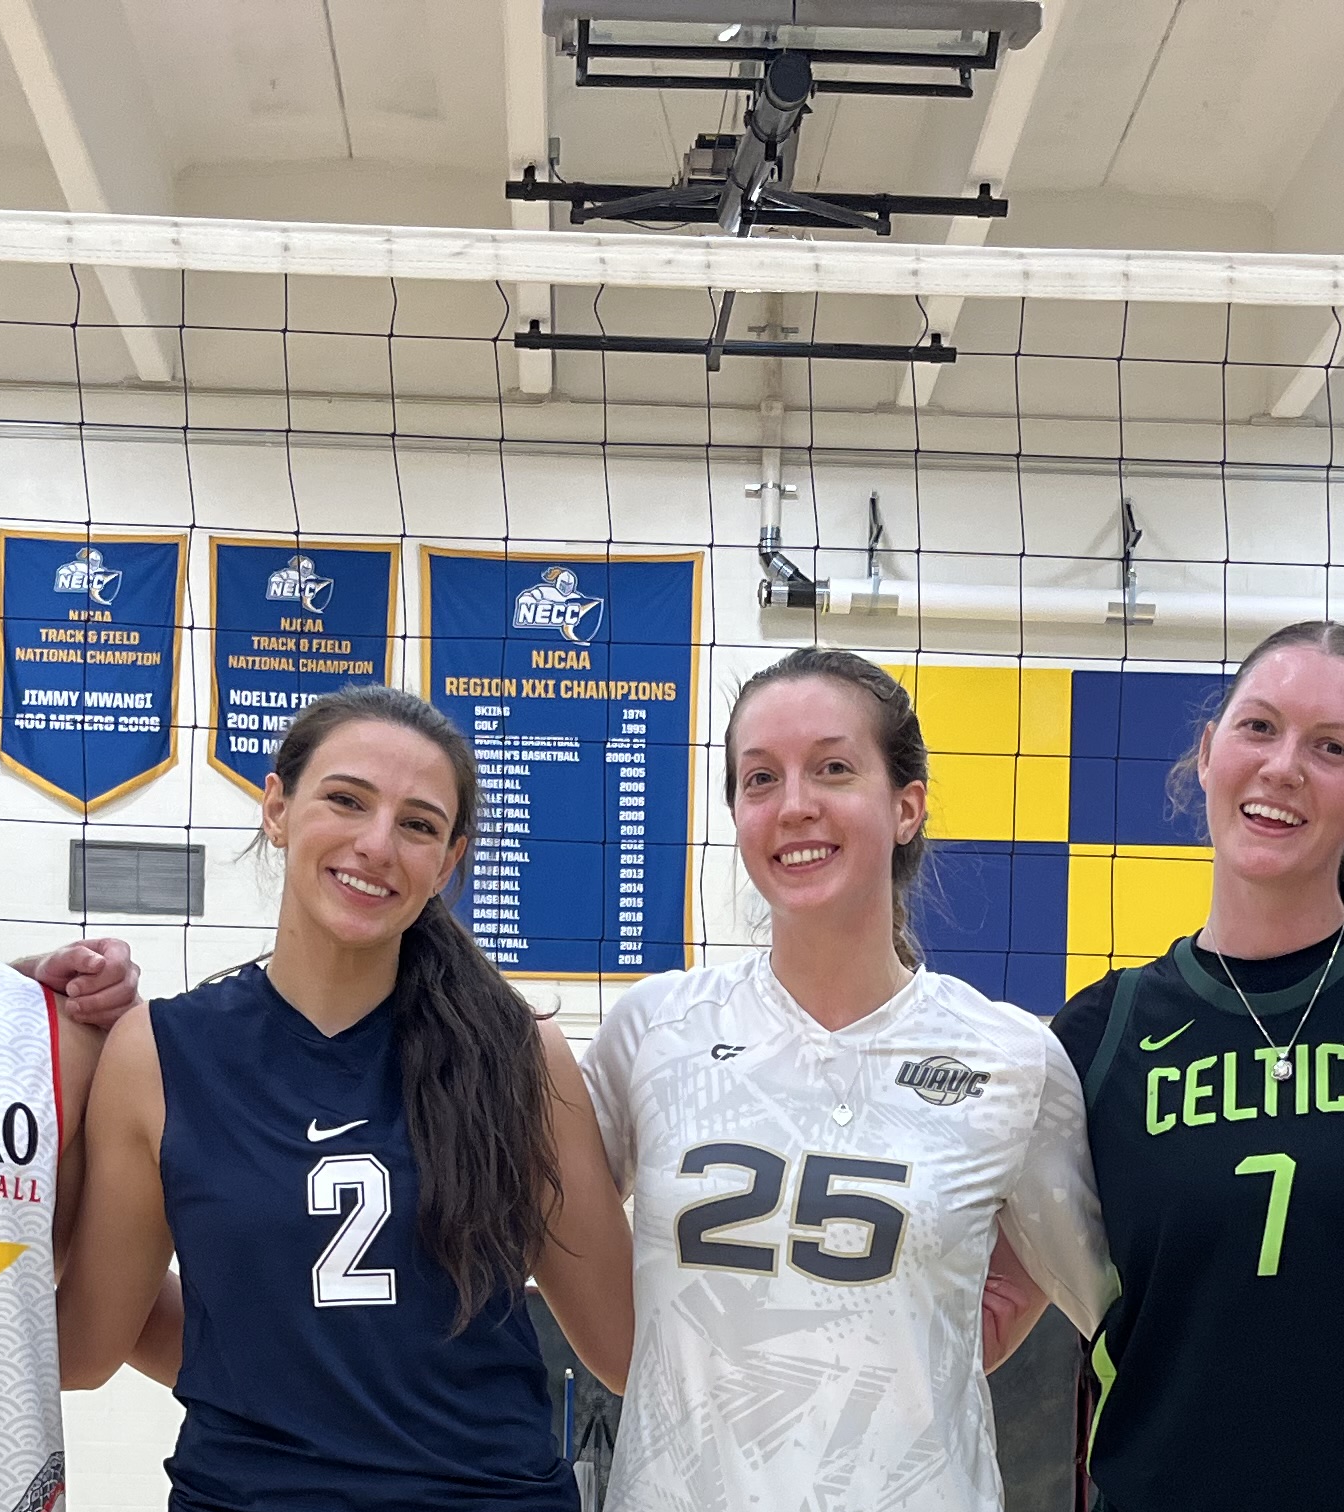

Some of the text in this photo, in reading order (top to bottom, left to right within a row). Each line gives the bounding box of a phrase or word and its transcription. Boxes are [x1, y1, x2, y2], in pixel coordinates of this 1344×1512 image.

[58, 574, 105, 589] NECC
[269, 581, 316, 597] NECC
[518, 602, 581, 624] NECC
[39, 628, 85, 644] TRACK
[100, 630, 140, 645] FIELD
[252, 636, 296, 651] TRACK
[312, 639, 351, 654] FIELD
[15, 647, 161, 666] NATIONAL CHAMPION
[228, 655, 374, 675] NATIONAL CHAMPION
[531, 650, 592, 670] NJCAA
[229, 689, 288, 708] NOELIA
[445, 677, 677, 701] REGION XXI CHAMPIONS
[21, 689, 153, 709] JIMMY MWANGI
[227, 712, 260, 730] 200
[474, 720, 499, 731] GOLF
[229, 736, 259, 753] 100
[521, 750, 580, 762] BASKETBALL
[673, 1138, 914, 1287] 25
[1234, 1153, 1297, 1277] 7
[307, 1153, 397, 1307] 2
